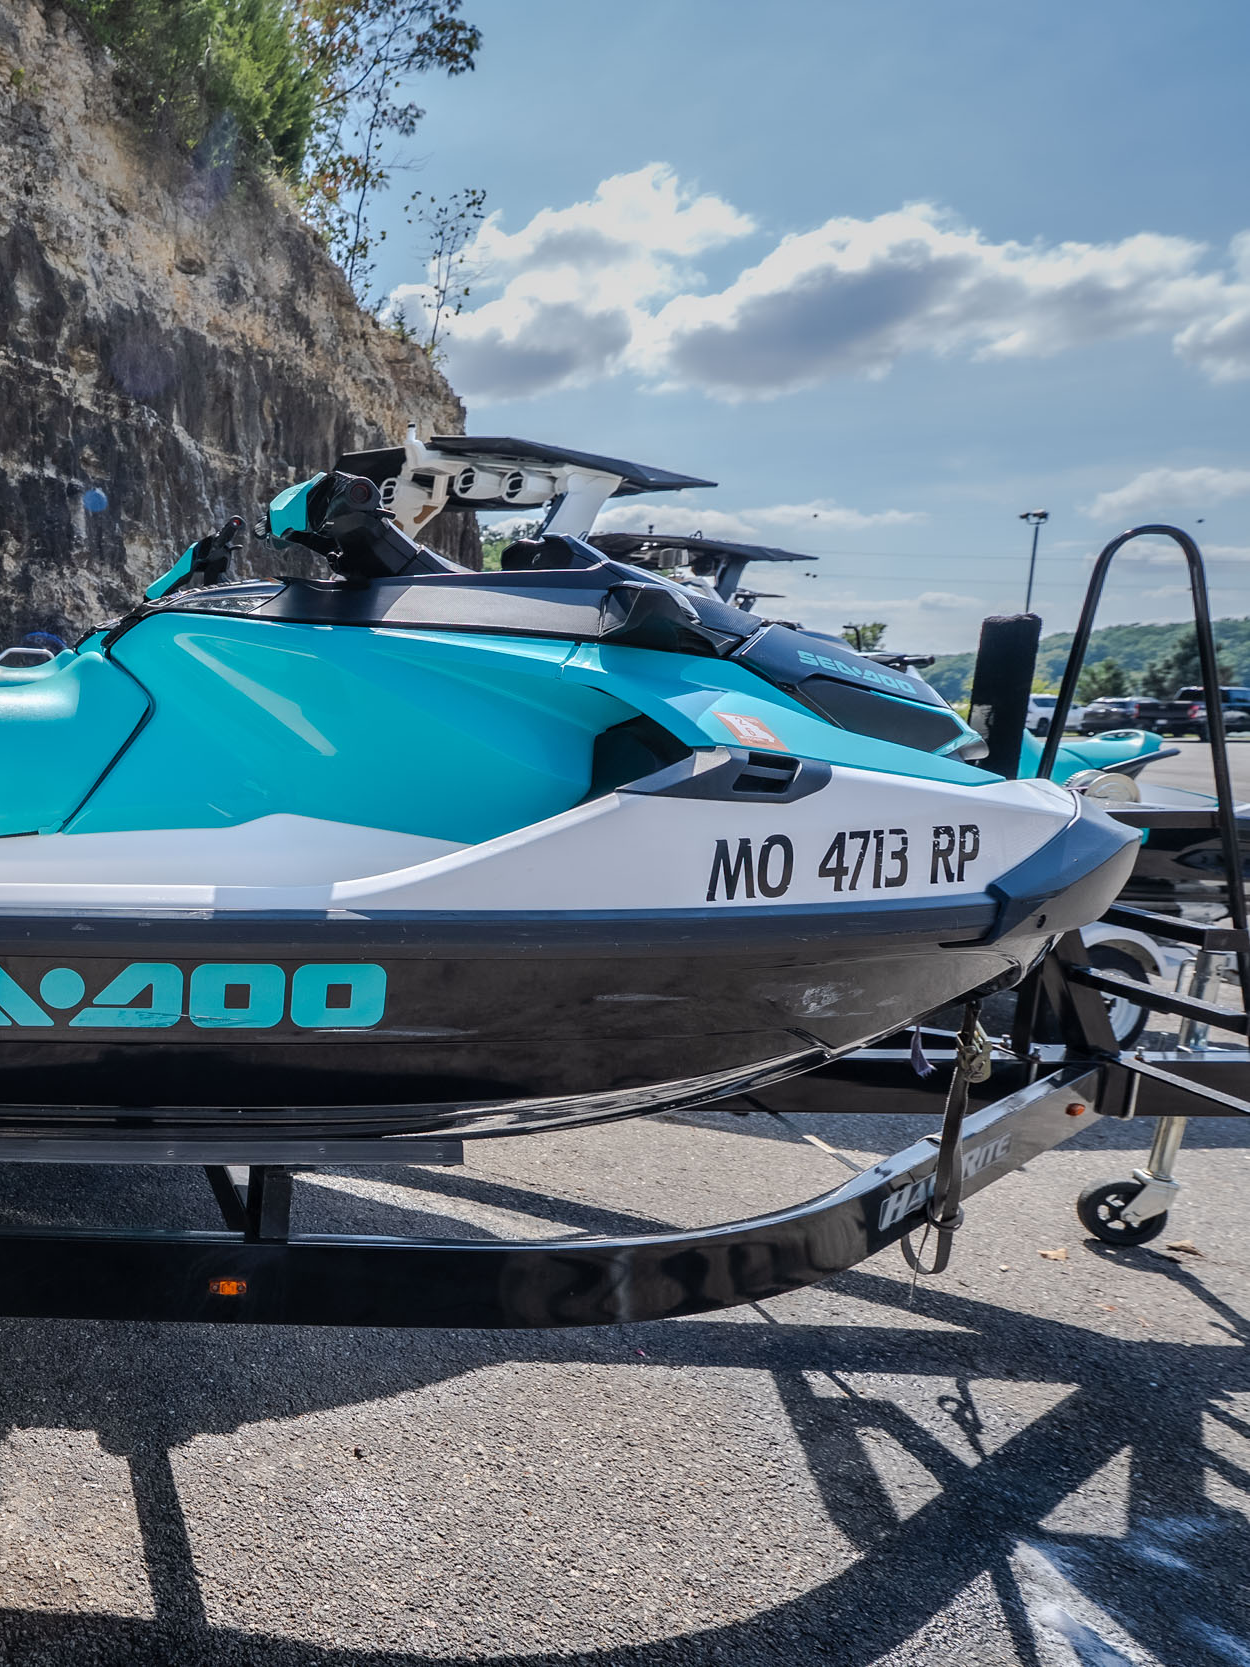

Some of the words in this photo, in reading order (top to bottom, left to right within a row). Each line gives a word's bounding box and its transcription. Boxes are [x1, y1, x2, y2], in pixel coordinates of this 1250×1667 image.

[706, 834, 794, 902] MO
[817, 828, 909, 892] 4713
[930, 824, 980, 884] RP
